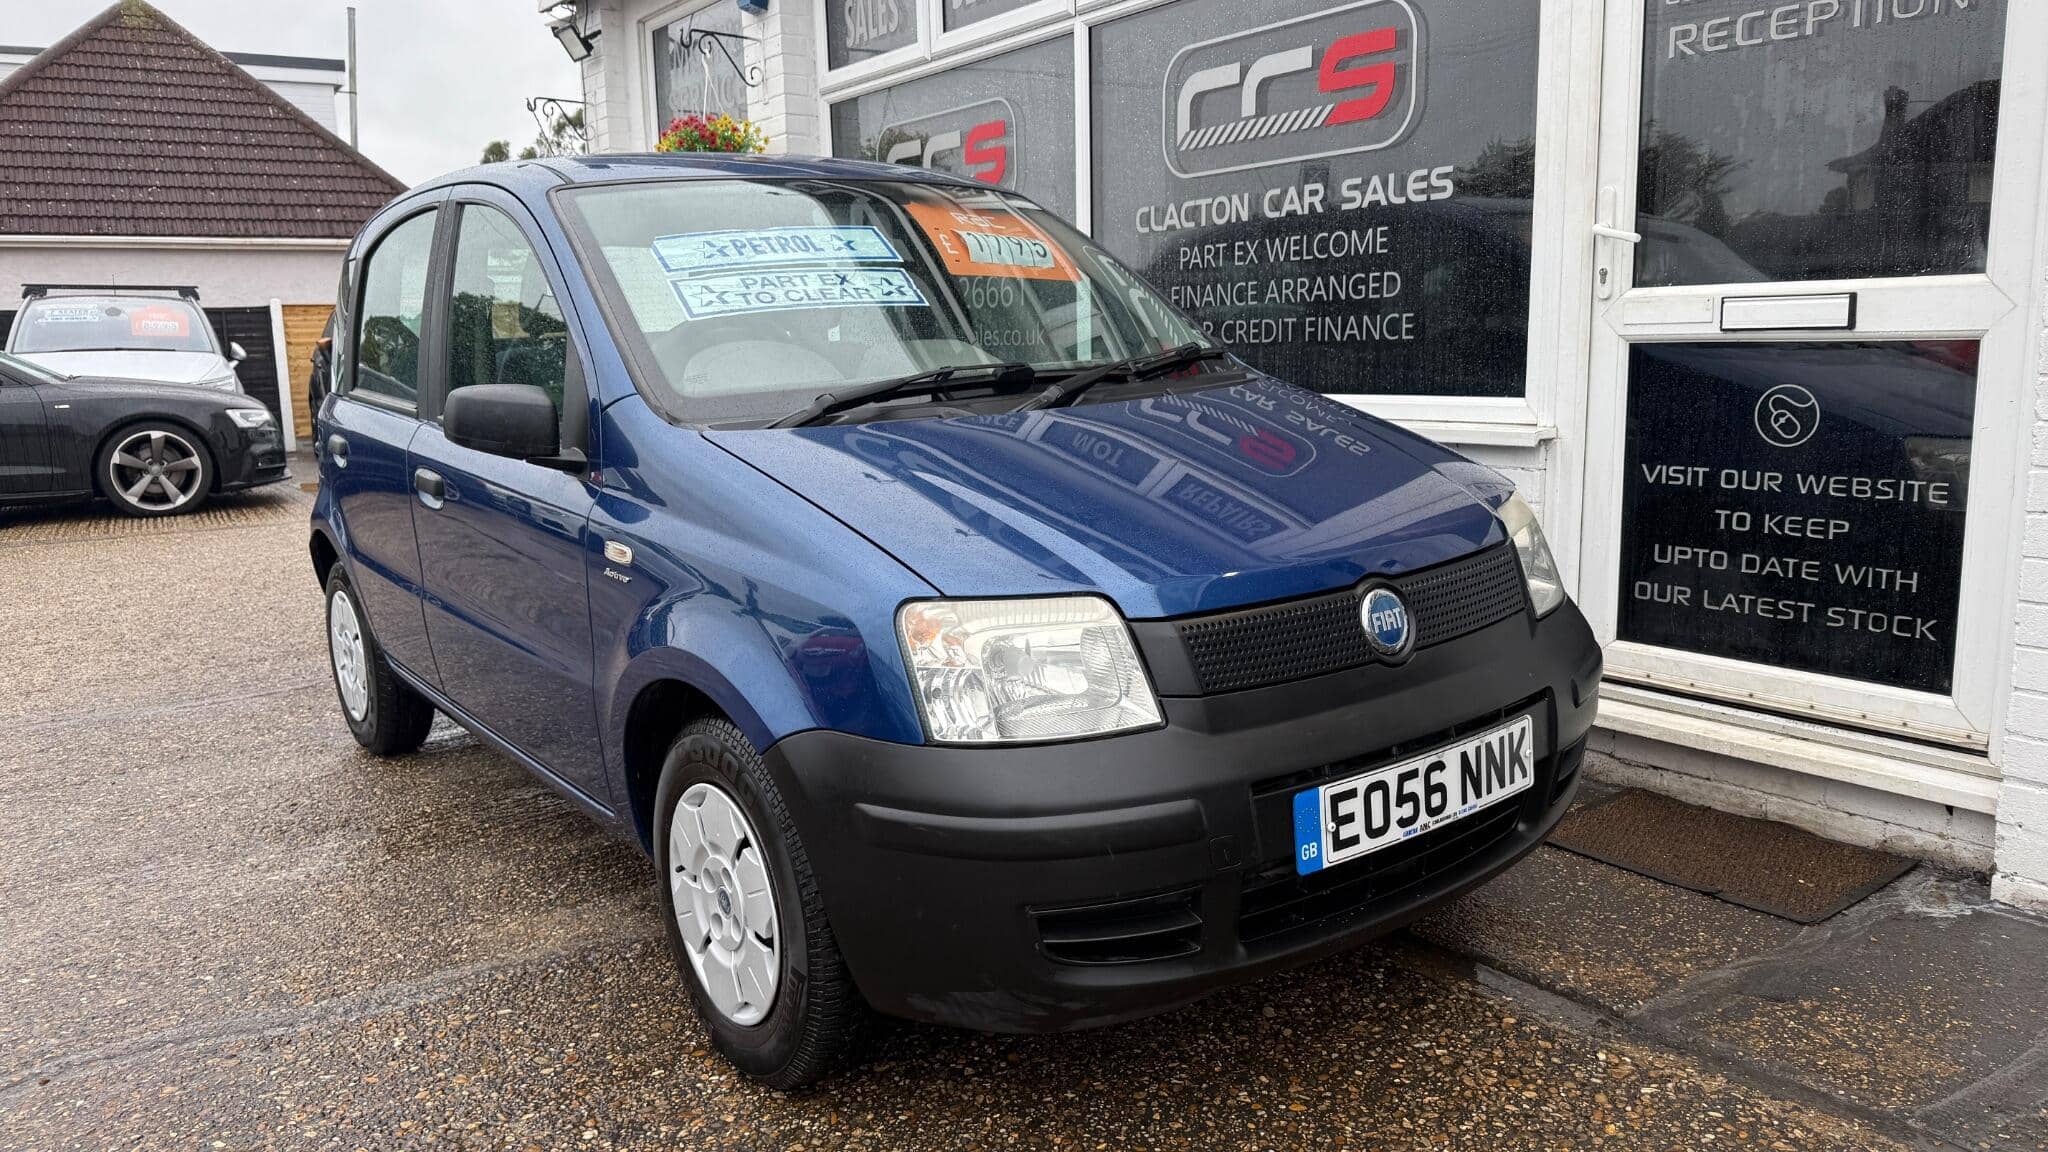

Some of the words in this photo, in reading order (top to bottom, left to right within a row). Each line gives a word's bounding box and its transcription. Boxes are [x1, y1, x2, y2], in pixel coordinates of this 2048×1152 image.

[1135, 193, 1250, 234] CLACTON
[1262, 184, 1325, 219] CAR
[1340, 165, 1455, 211] SALES
[727, 235, 826, 258] PETROL
[1179, 242, 1227, 270] PART
[1233, 240, 1262, 266] EX
[1266, 226, 1389, 261] WELCOME
[738, 289, 778, 306] TO
[782, 286, 877, 303] CLEAR
[740, 273, 810, 291] PART
[816, 272, 855, 287] EX
[1171, 280, 1258, 309] FINANCE
[1265, 270, 1402, 303] ARRANGED
[1221, 317, 1298, 345] CREDIT
[1304, 312, 1415, 342] FINANCE
[1641, 463, 1710, 487] VISIT
[1720, 468, 1783, 493] OUR
[1796, 472, 1950, 505] WEBSITE
[1714, 508, 1751, 532] TO
[1763, 513, 1850, 540] KEEP
[1653, 543, 1728, 571] UPTO
[1741, 553, 1821, 582] DATE
[1834, 562, 1919, 593] WITH
[1371, 606, 1403, 634] FIAT
[1634, 580, 1692, 606] OUR
[1703, 589, 1817, 623] LATEST
[1826, 606, 1939, 642] STOCK
[1330, 760, 1448, 853] EO56
[1459, 725, 1529, 807] NNK
[1300, 841, 1318, 861] GB
